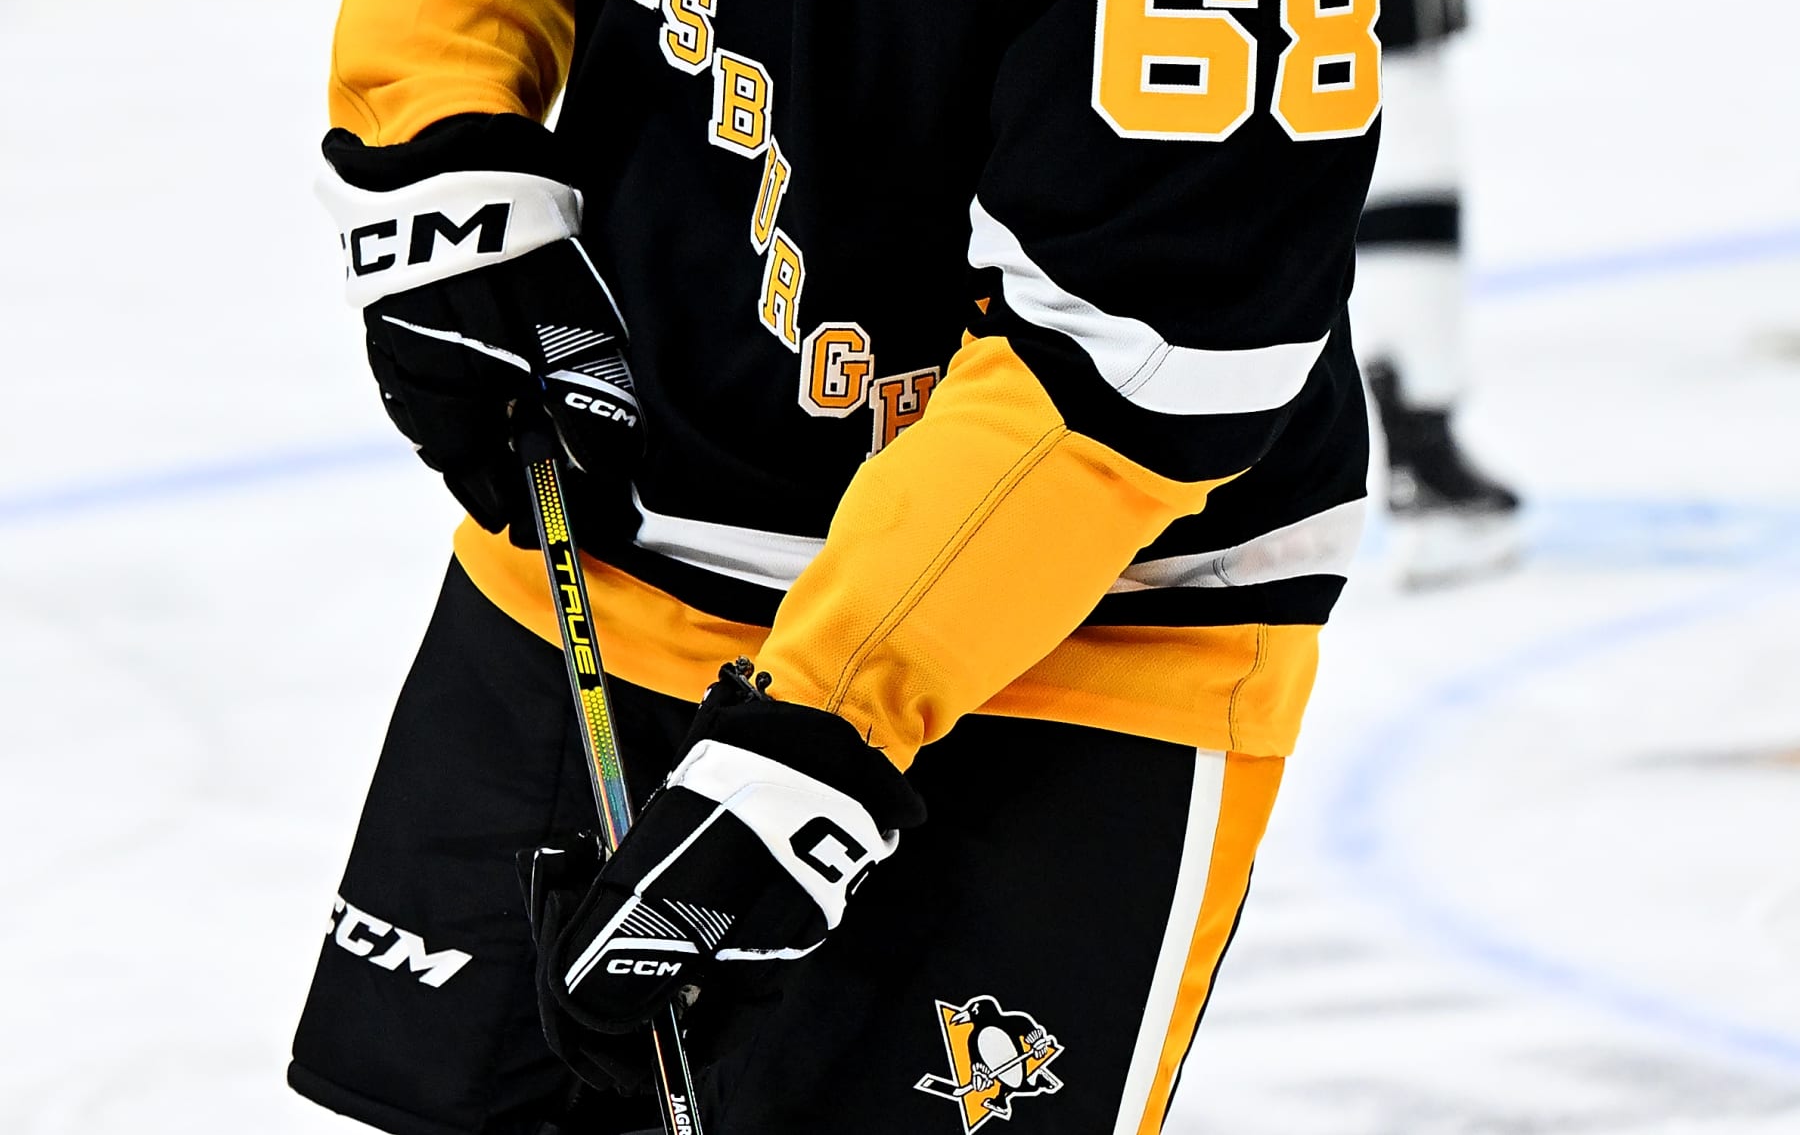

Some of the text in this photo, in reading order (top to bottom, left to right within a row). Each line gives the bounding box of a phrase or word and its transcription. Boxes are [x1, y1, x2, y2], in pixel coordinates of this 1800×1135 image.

[339, 202, 511, 282] CM
[564, 391, 637, 428] CCM
[555, 549, 597, 676] TRUE
[606, 958, 682, 977] CCM
[670, 1093, 693, 1135] JAGR
